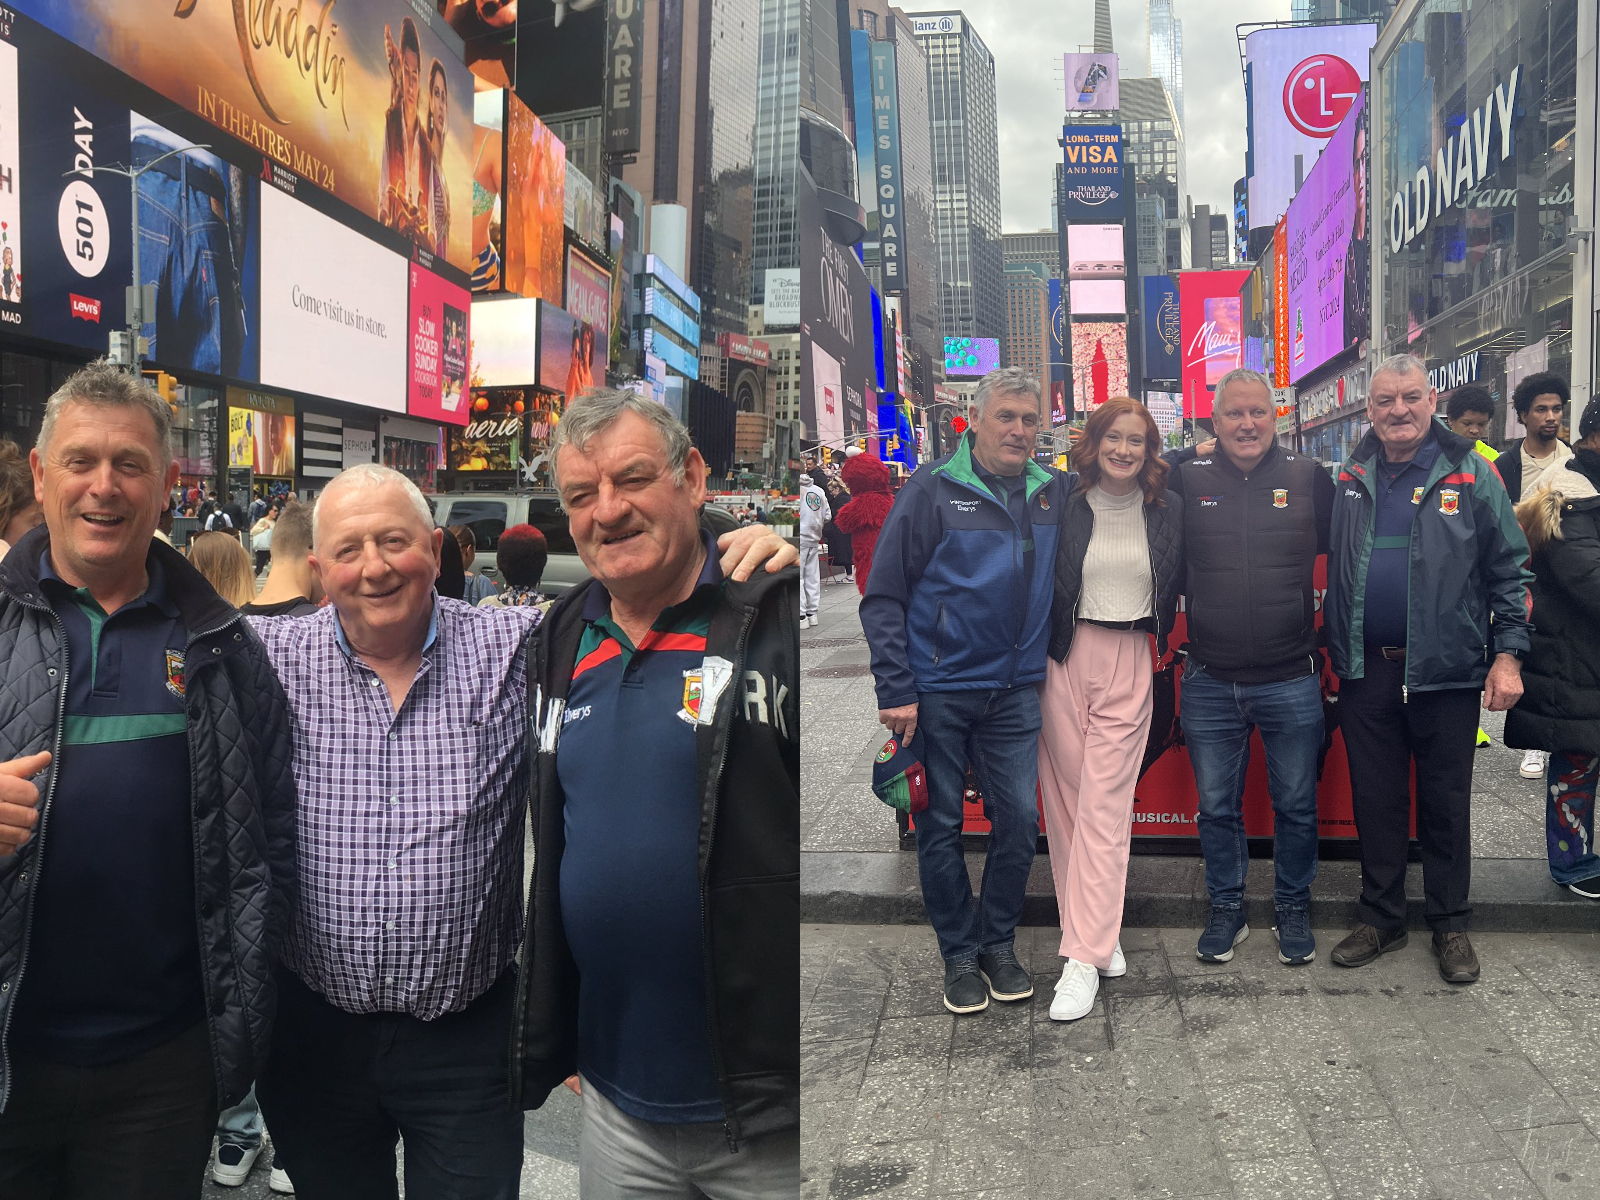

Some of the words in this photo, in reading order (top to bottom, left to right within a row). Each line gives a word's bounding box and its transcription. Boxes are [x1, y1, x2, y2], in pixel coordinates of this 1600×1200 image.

[874, 55, 891, 151] TIMES
[73, 106, 94, 179] DAY
[196, 85, 217, 122] IN
[218, 97, 291, 166] THEATRES
[293, 145, 322, 184] MAY
[321, 165, 336, 193] 24
[1066, 135, 1119, 143] LONG-TERM
[1066, 145, 1118, 163] VISA
[1390, 165, 1431, 254] OLD
[1435, 64, 1520, 218] NAVY
[273, 165, 298, 185] MARRIOTT
[1091, 166, 1119, 174] MORE
[273, 175, 295, 194] MARQUIS
[1068, 190, 1108, 200] PRIVILEGE
[75, 198, 94, 262] 501
[880, 164, 899, 277] SQUARE
[821, 226, 834, 265] THE
[834, 247, 849, 286] FIRST
[292, 284, 322, 316] Come
[323, 298, 343, 323] visit
[344, 310, 355, 328] us
[355, 308, 365, 331] in
[365, 316, 388, 339] store.
[422, 304, 432, 317] BUY
[821, 256, 855, 348] OMEN
[1, 309, 22, 324] MAD
[418, 316, 435, 337] SLOW
[1164, 291, 1174, 341] PRIVILEGE
[414, 333, 439, 357] COOKER
[1187, 320, 1236, 356] Maui
[414, 352, 438, 374] SUNDAY
[1428, 366, 1447, 394] OLD
[1448, 350, 1479, 390] NAVY
[414, 369, 438, 388] COOKBOOK
[418, 384, 433, 399] TODAY
[464, 411, 523, 440] aerie
[344, 439, 372, 452] SEPHORA
[563, 705, 593, 724] Elverys
